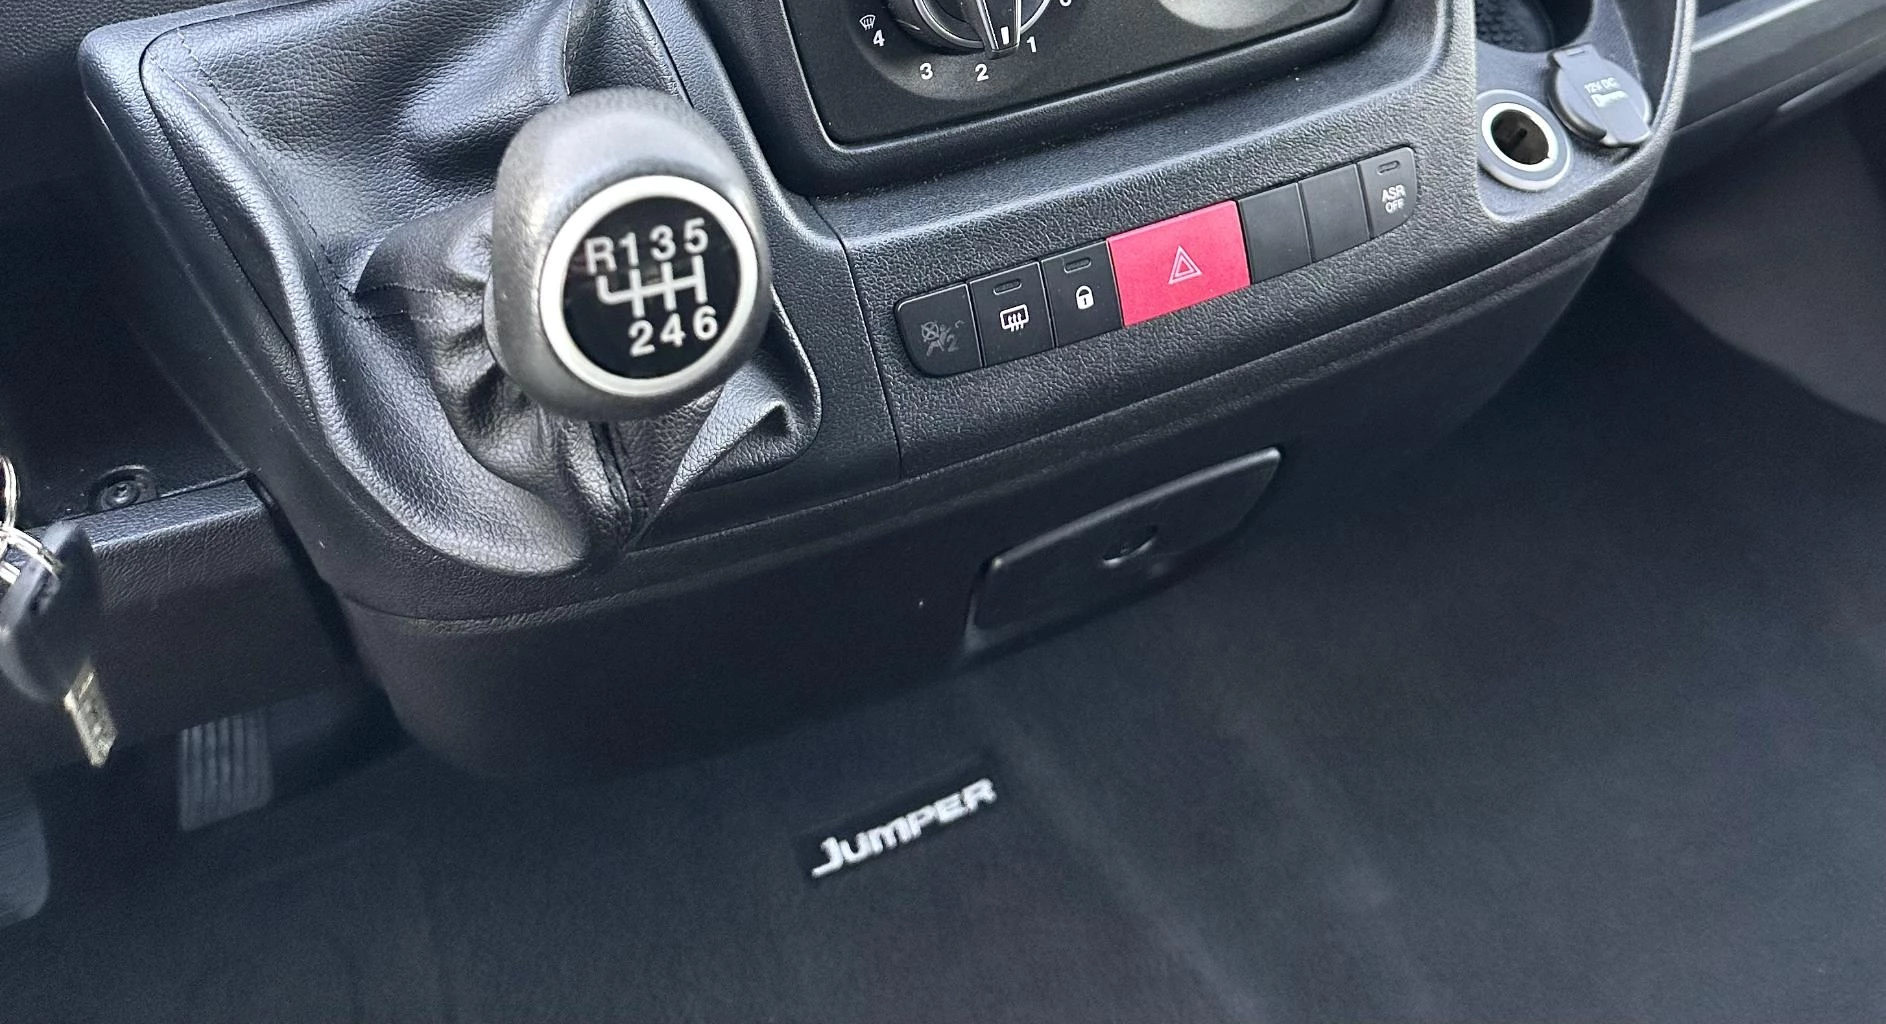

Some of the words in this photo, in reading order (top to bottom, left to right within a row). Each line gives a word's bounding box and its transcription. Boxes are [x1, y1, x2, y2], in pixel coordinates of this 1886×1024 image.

[872, 29, 886, 47] 4
[1026, 36, 1037, 53] 1
[919, 62, 934, 80] 3
[974, 63, 990, 82] 2
[1381, 184, 1407, 203] ASR
[1385, 198, 1405, 214] OFF
[584, 236, 617, 275] R
[618, 231, 640, 267] 1
[650, 224, 676, 262] 3
[683, 217, 709, 254] 5
[628, 319, 655, 358] 2
[660, 312, 686, 348] 4
[693, 305, 718, 341] 6
